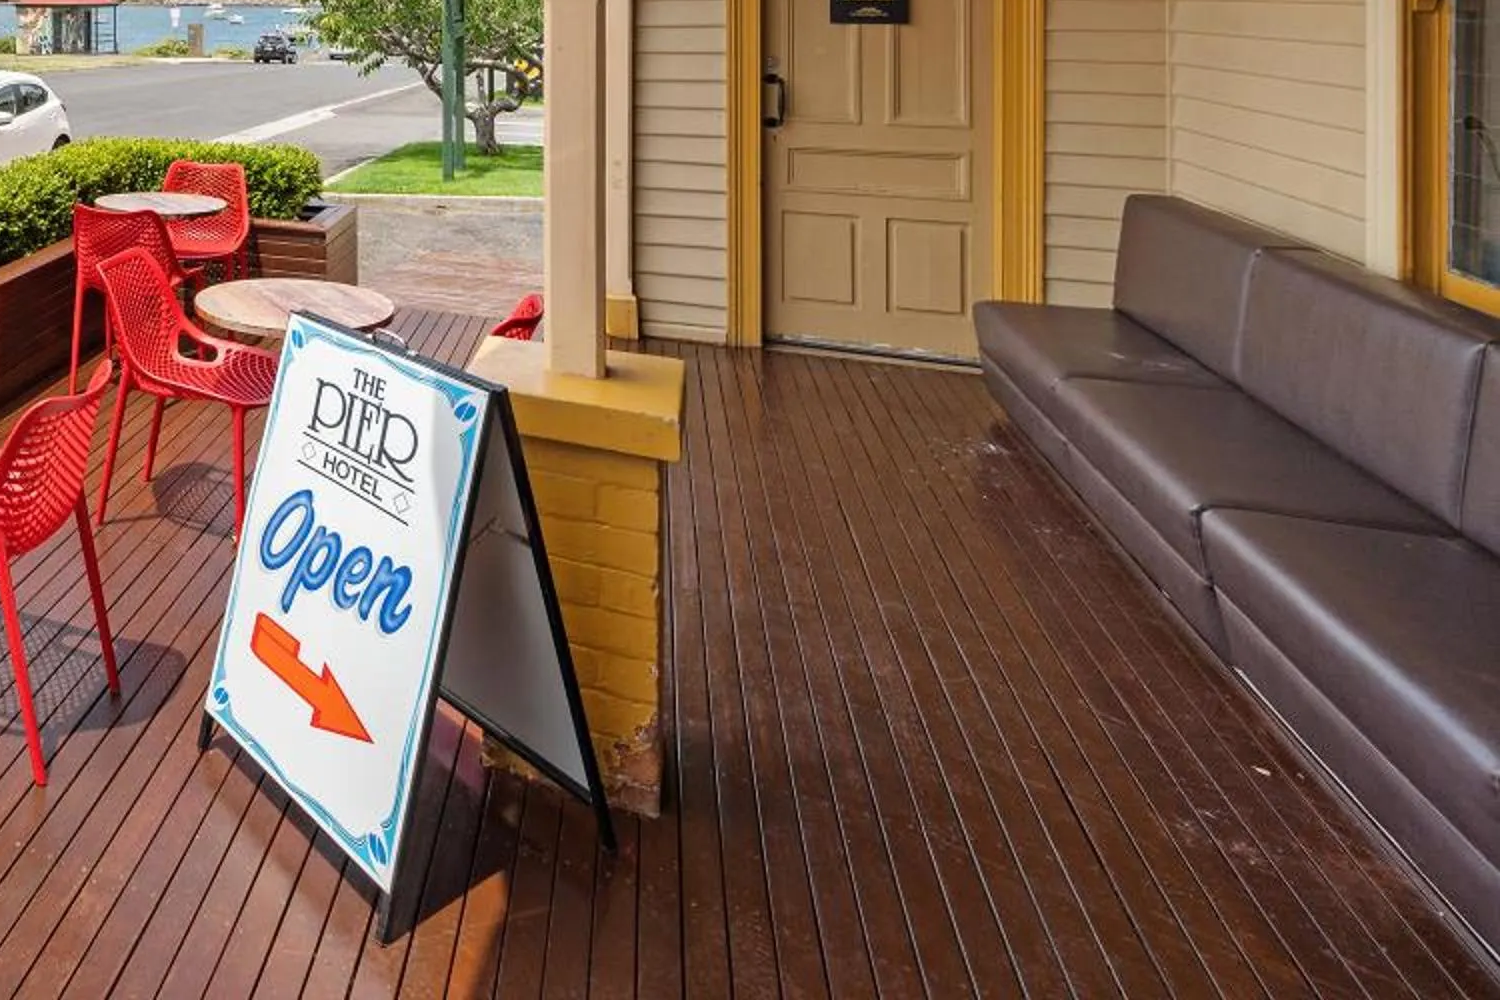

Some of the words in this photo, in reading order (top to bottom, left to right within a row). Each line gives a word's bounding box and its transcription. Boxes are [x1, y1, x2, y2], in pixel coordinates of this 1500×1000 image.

[353, 368, 387, 401] THE
[307, 377, 418, 482] PIER
[323, 451, 382, 502] HOTEL
[260, 489, 413, 635] Open
